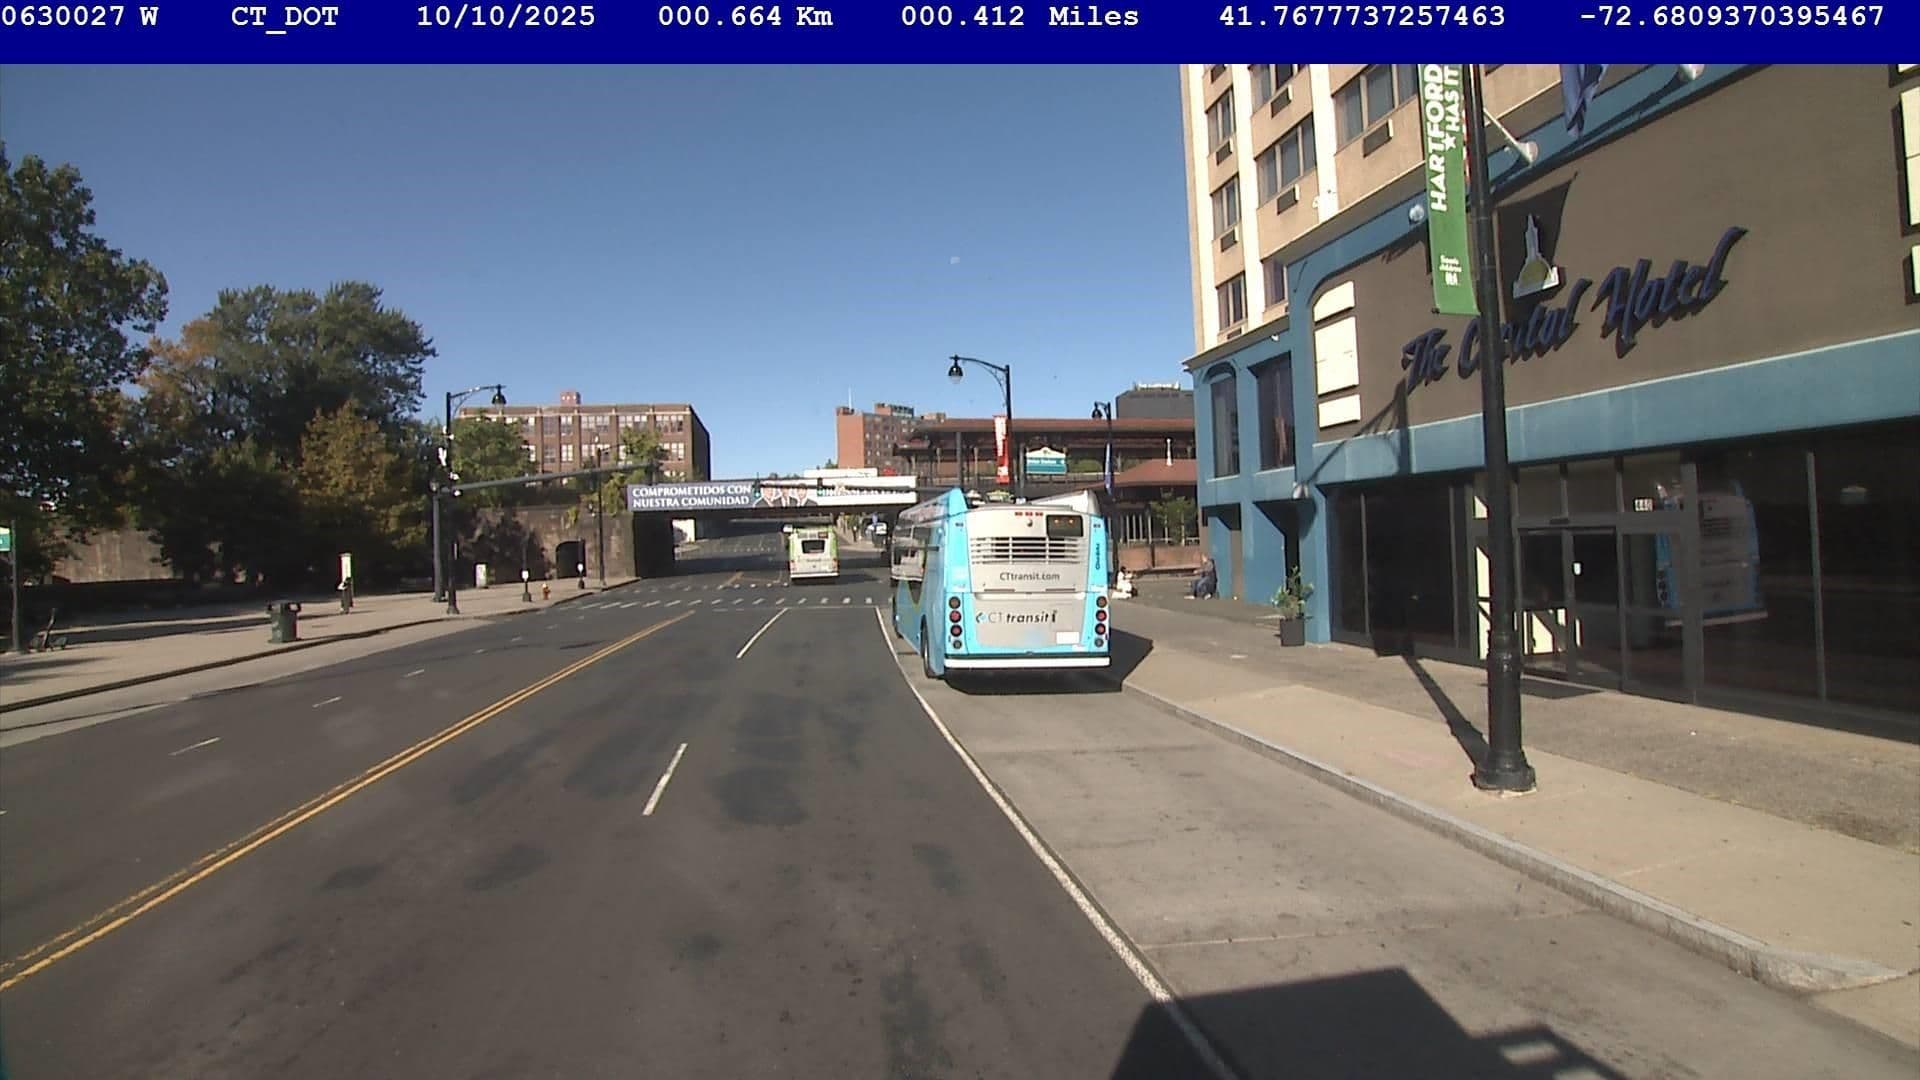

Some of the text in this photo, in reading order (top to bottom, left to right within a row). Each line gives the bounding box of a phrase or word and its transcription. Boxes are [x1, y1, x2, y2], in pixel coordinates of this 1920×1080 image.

[1443, 65, 1461, 132] HAS IT
[1423, 63, 1448, 212] HARTFORD
[1401, 327, 1452, 396] The
[1592, 226, 1749, 358] Hotel
[631, 484, 751, 498] COMPROMETIDOS CON
[633, 495, 749, 508] NUESTRA COMUNIDAD
[999, 571, 1061, 581] CTtransit.com
